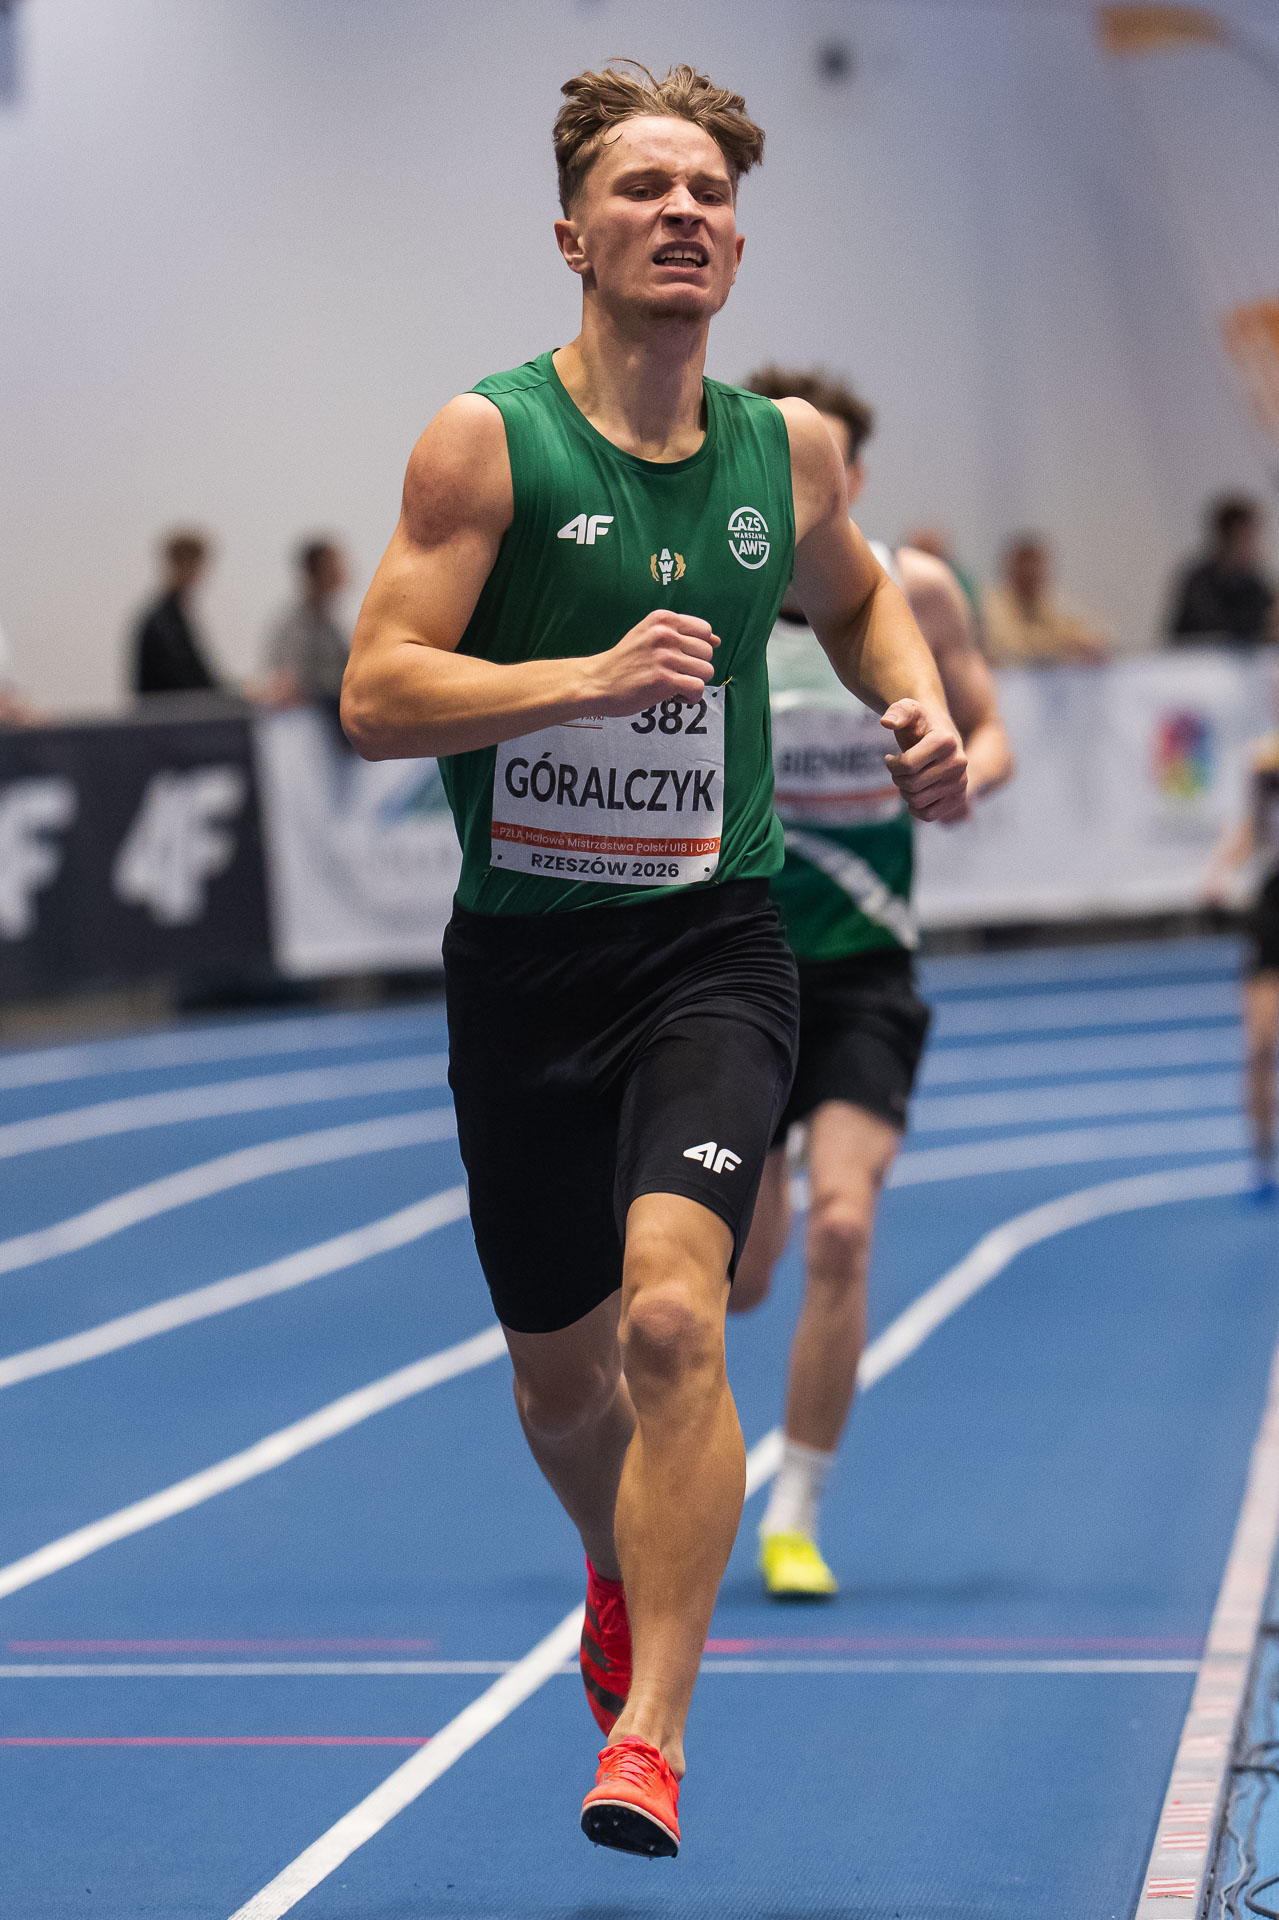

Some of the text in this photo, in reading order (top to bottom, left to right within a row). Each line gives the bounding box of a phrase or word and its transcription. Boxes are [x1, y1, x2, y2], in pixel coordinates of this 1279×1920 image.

[556, 513, 615, 545] 4F
[733, 531, 766, 540] WARSZAWA
[737, 516, 762, 532] AZS
[738, 540, 770, 556] AWF
[630, 697, 708, 735] 382
[504, 752, 717, 812] GÓRALCZYK
[112, 766, 245, 925] 4F
[525, 831, 565, 847] Halowe
[567, 837, 634, 852] Mistrzostwa
[636, 842, 668, 853] Polski
[669, 843, 688, 853] U18
[690, 844, 694, 853] i
[696, 841, 716, 852] U20
[531, 853, 680, 878] RZESZÓW 2026
[682, 1141, 743, 1174] 4F
